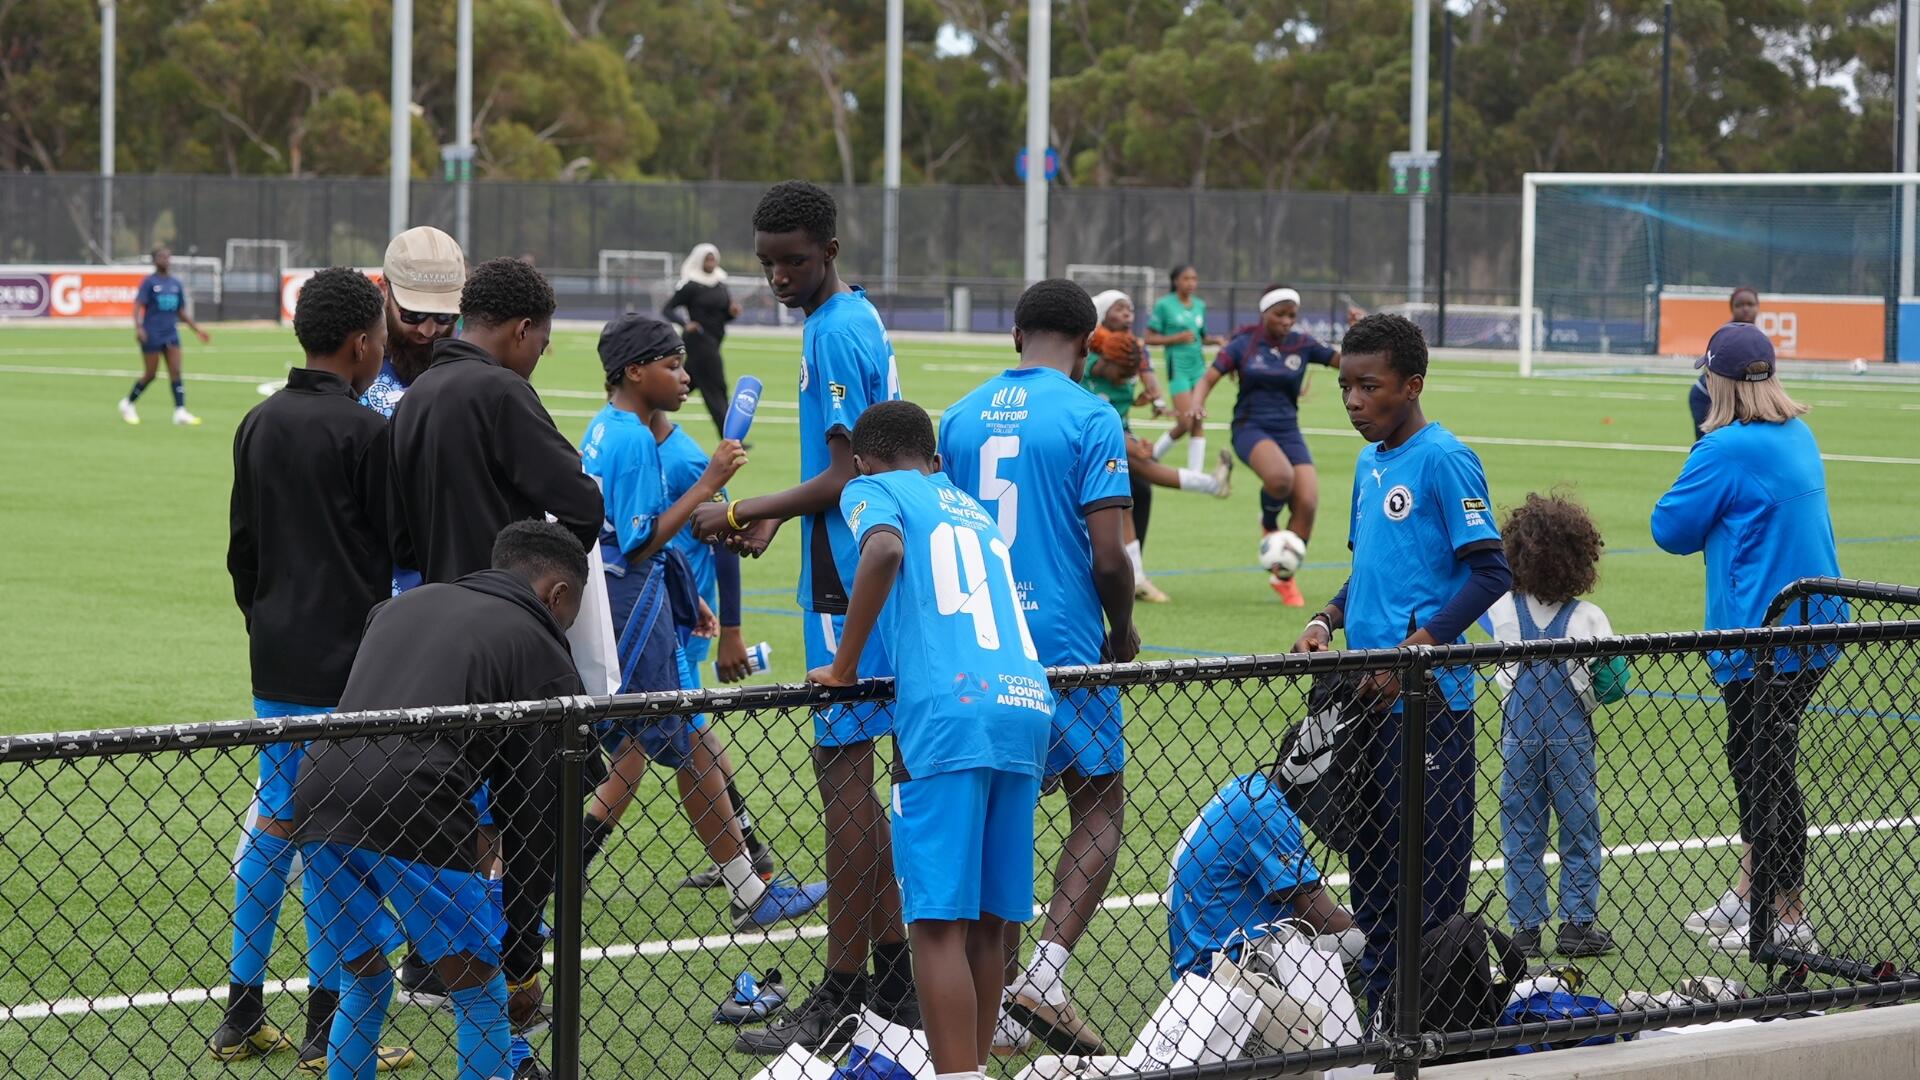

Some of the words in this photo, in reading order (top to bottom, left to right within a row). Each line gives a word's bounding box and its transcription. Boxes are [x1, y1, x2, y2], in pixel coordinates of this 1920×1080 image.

[980, 410, 1029, 421] PLAYFORD
[979, 435, 1020, 550] 5
[1008, 684, 1045, 702] SOUTH
[997, 694, 1052, 716] AUSTRALIA
